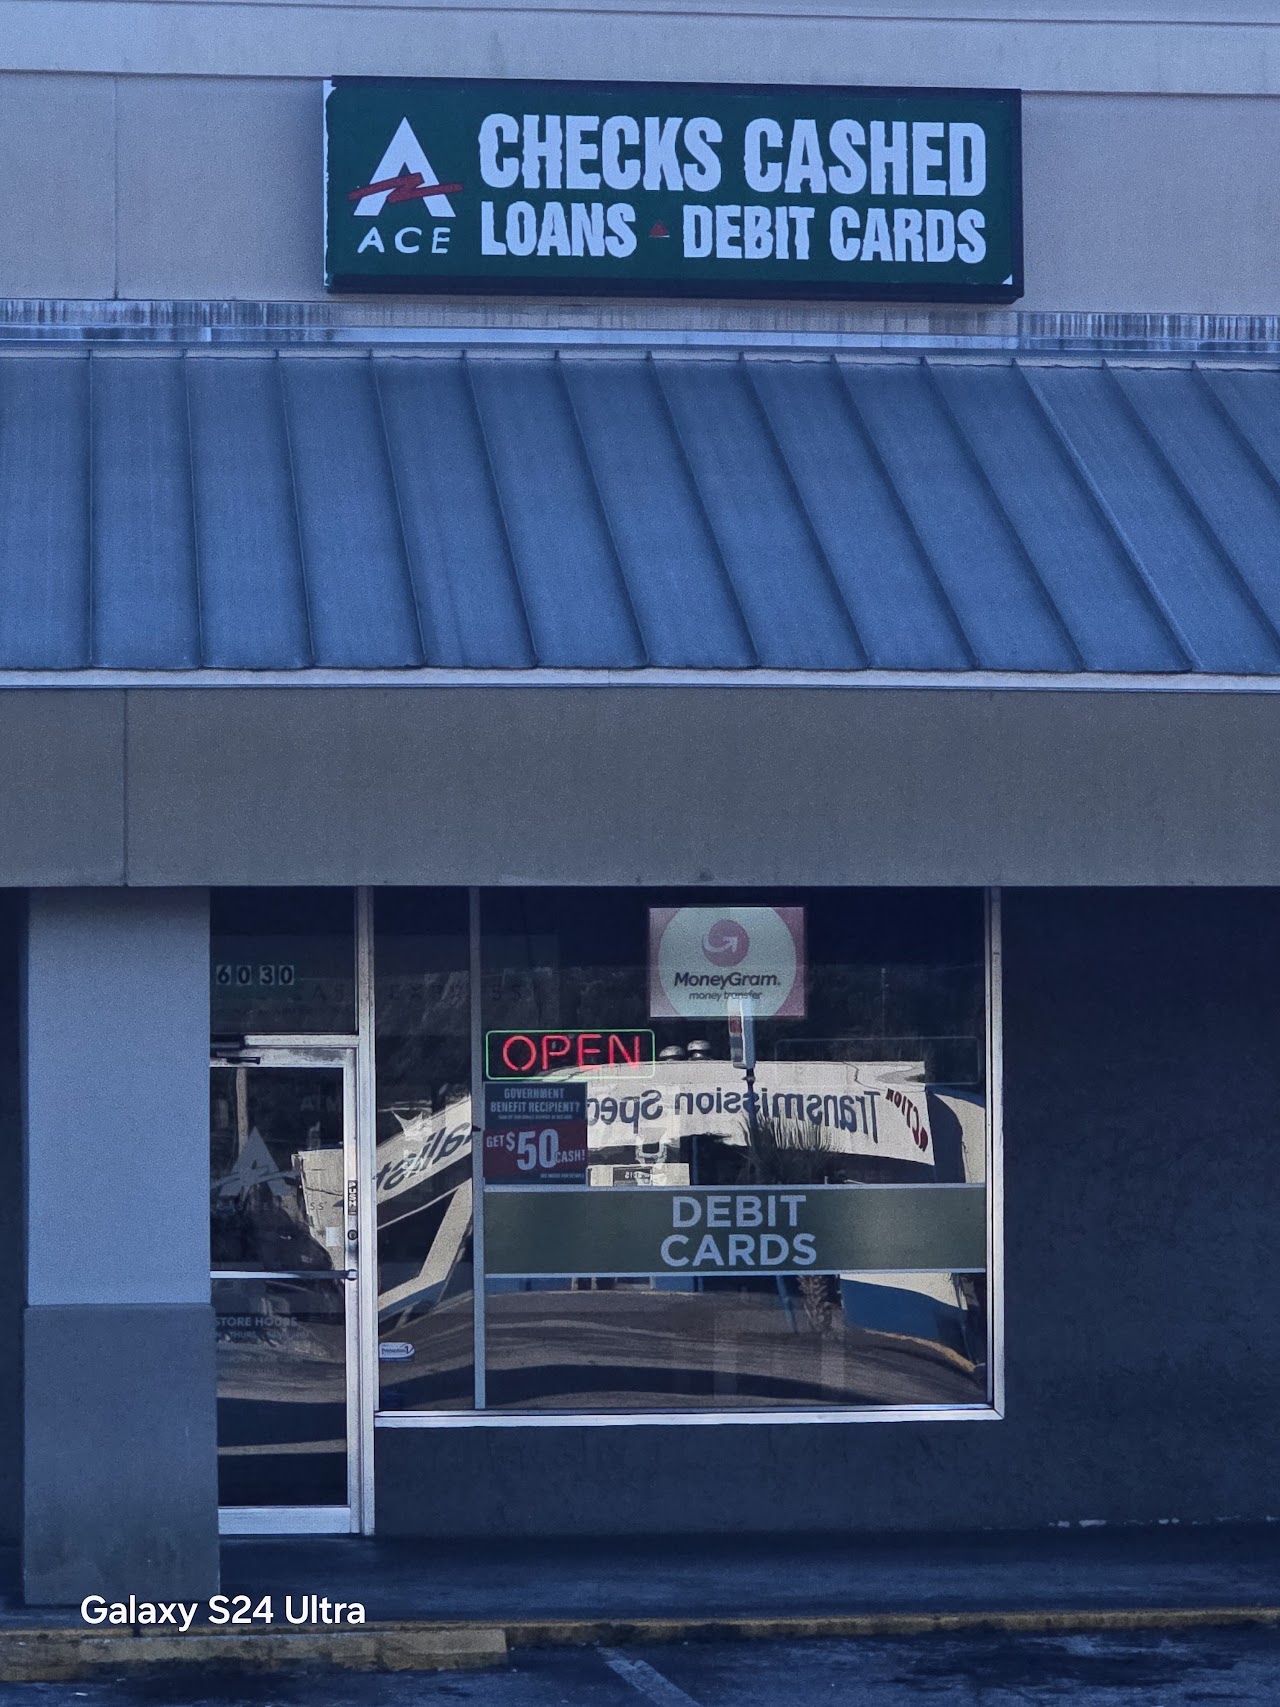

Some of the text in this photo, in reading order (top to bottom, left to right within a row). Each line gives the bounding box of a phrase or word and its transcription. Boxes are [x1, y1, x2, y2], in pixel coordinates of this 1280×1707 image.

[478, 114, 986, 197] CHECKS CASHED
[357, 226, 451, 254] ACE
[481, 201, 986, 264] LOANS DEBIT CARDS
[216, 965, 294, 986] 6030
[689, 990, 762, 1001] money transfer
[502, 1034, 640, 1071] OPEN
[490, 1102, 580, 1112] BENEFIT RECIPIENT?
[504, 1088, 565, 1099] GOVERNMENT
[486, 1128, 586, 1171] GET $50 CASH!
[349, 1181, 357, 1207] PUSH
[672, 1194, 807, 1228] DEBIT
[660, 1233, 818, 1268] CARDS
[215, 1316, 252, 1327] STORE
